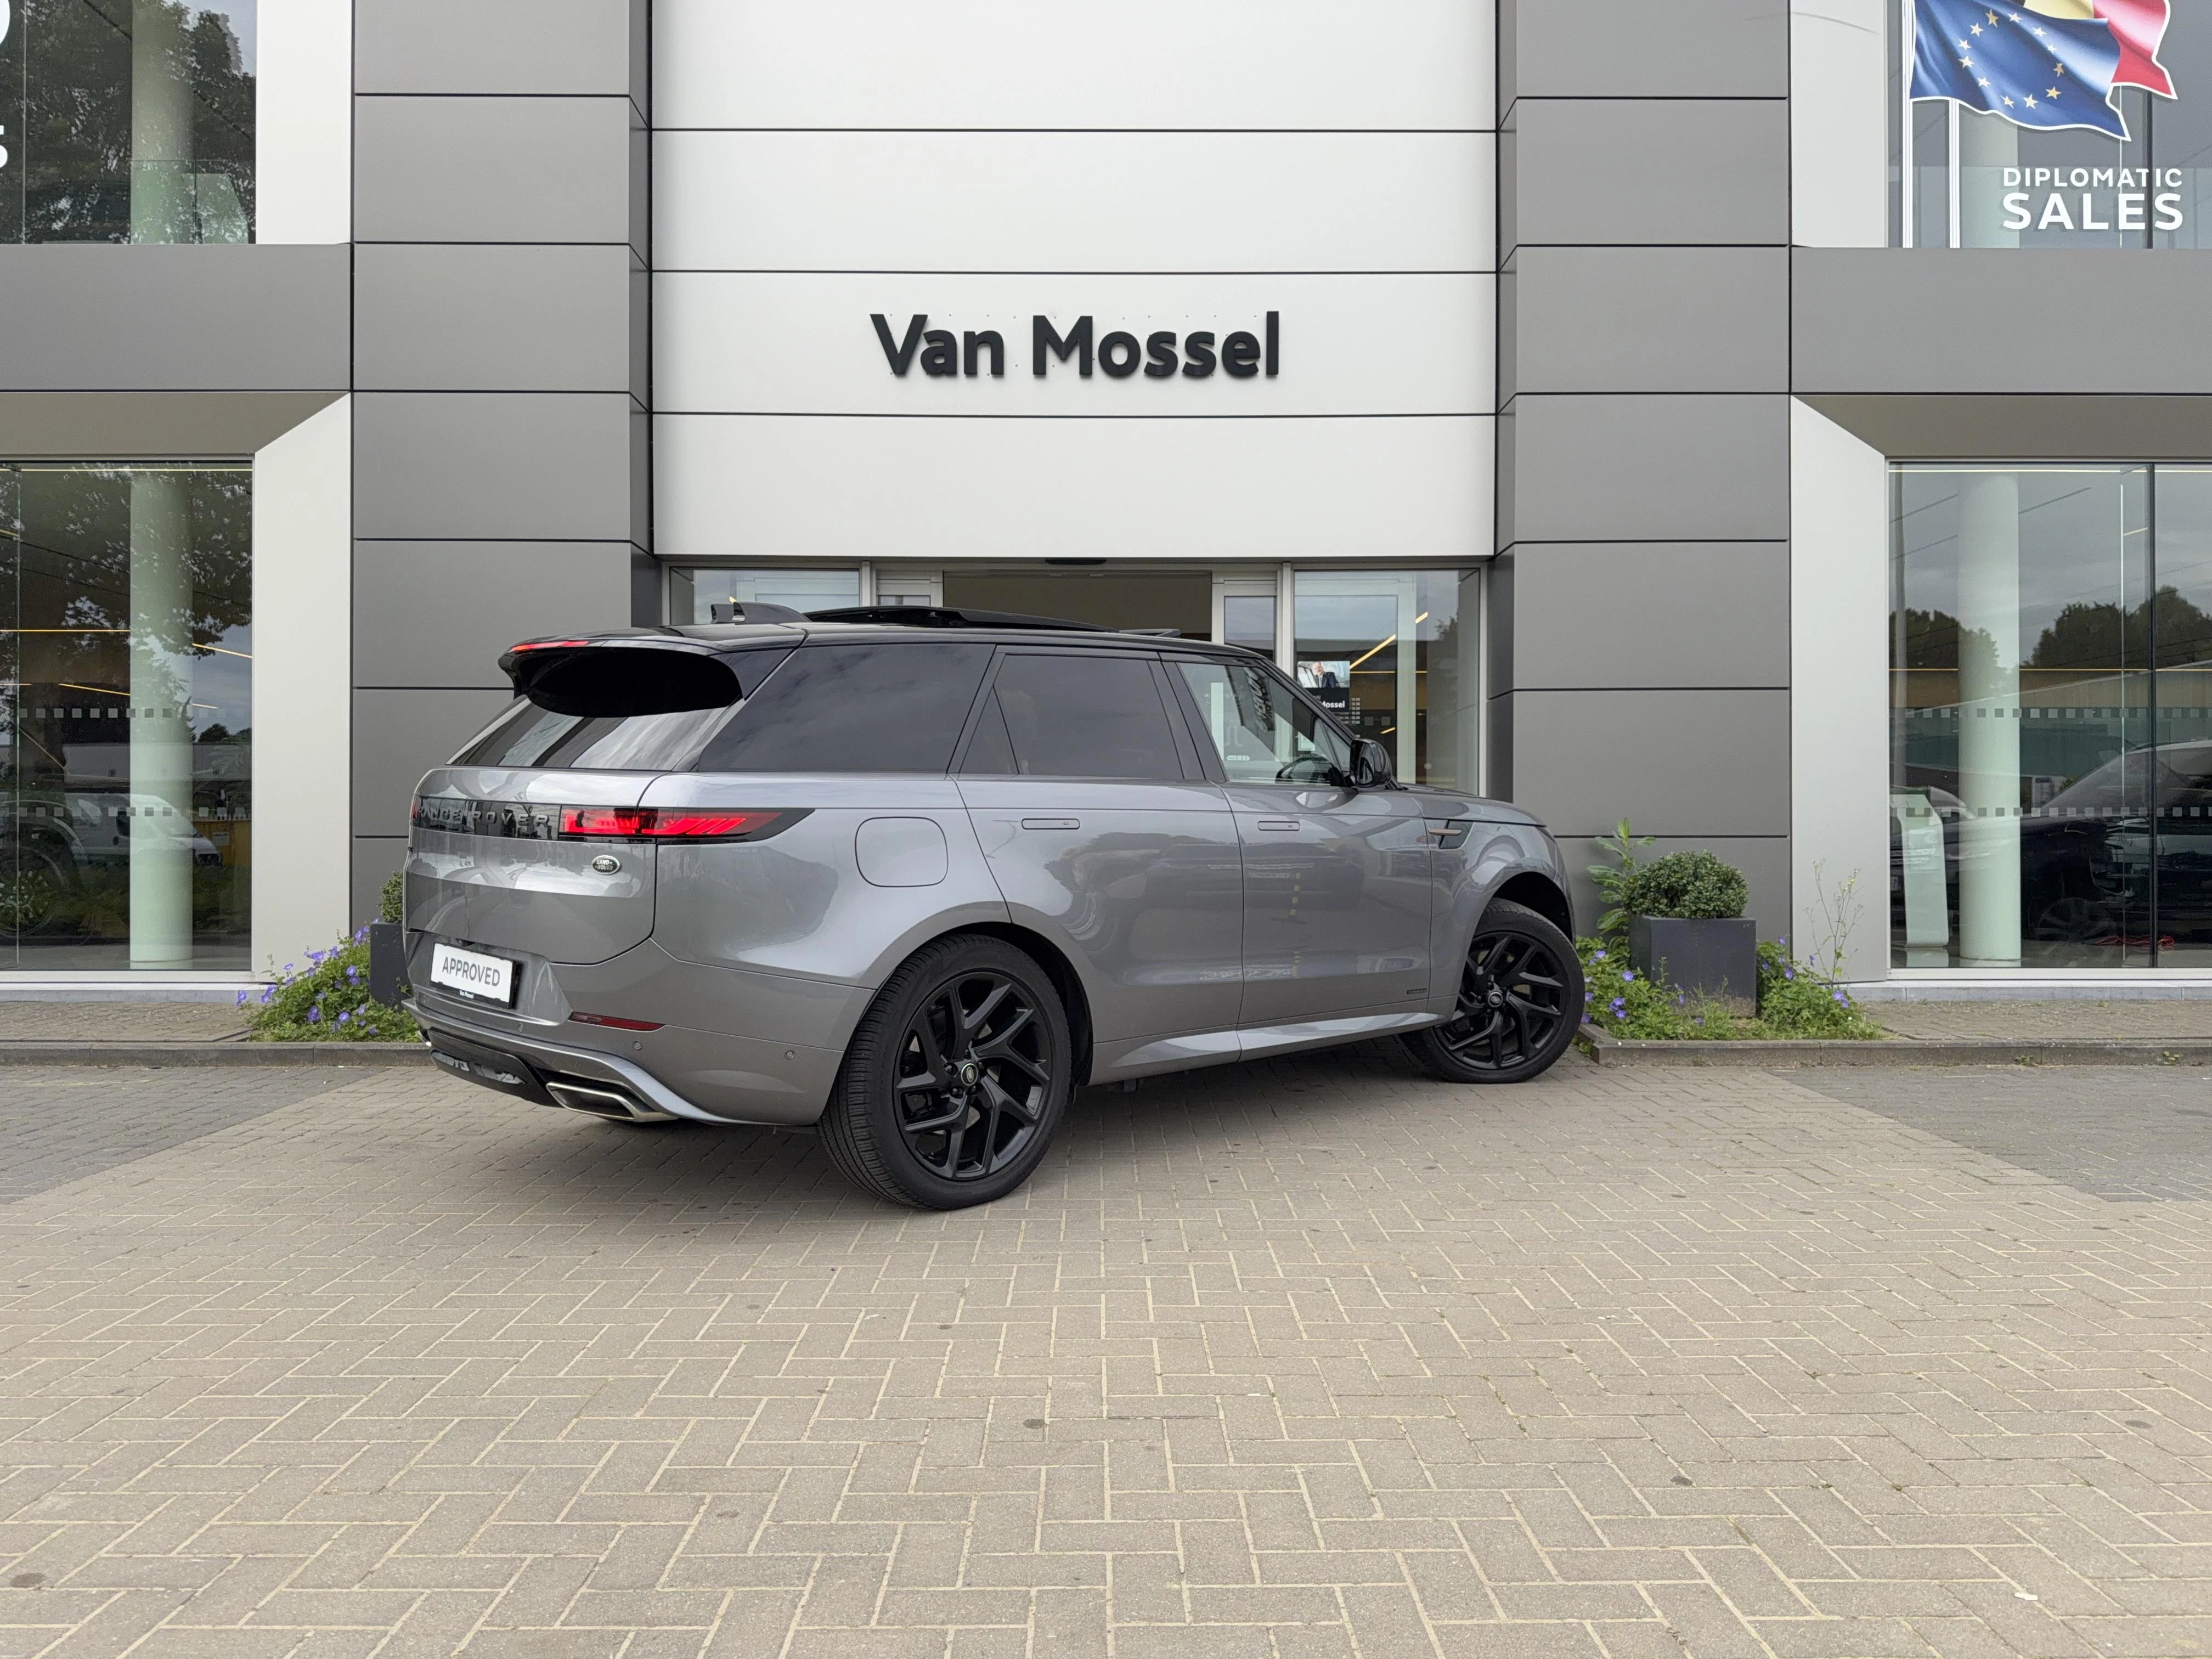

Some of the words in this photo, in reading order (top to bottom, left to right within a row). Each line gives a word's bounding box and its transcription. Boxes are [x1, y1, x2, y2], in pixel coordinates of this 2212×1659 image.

[2004, 168, 2182, 187] DIPLOMATIC
[2003, 193, 2183, 230] SALES
[870, 314, 1005, 377] Van
[1032, 311, 1279, 377] Mossel
[472, 810, 549, 827] ROVER
[442, 956, 500, 987] APPROVED
